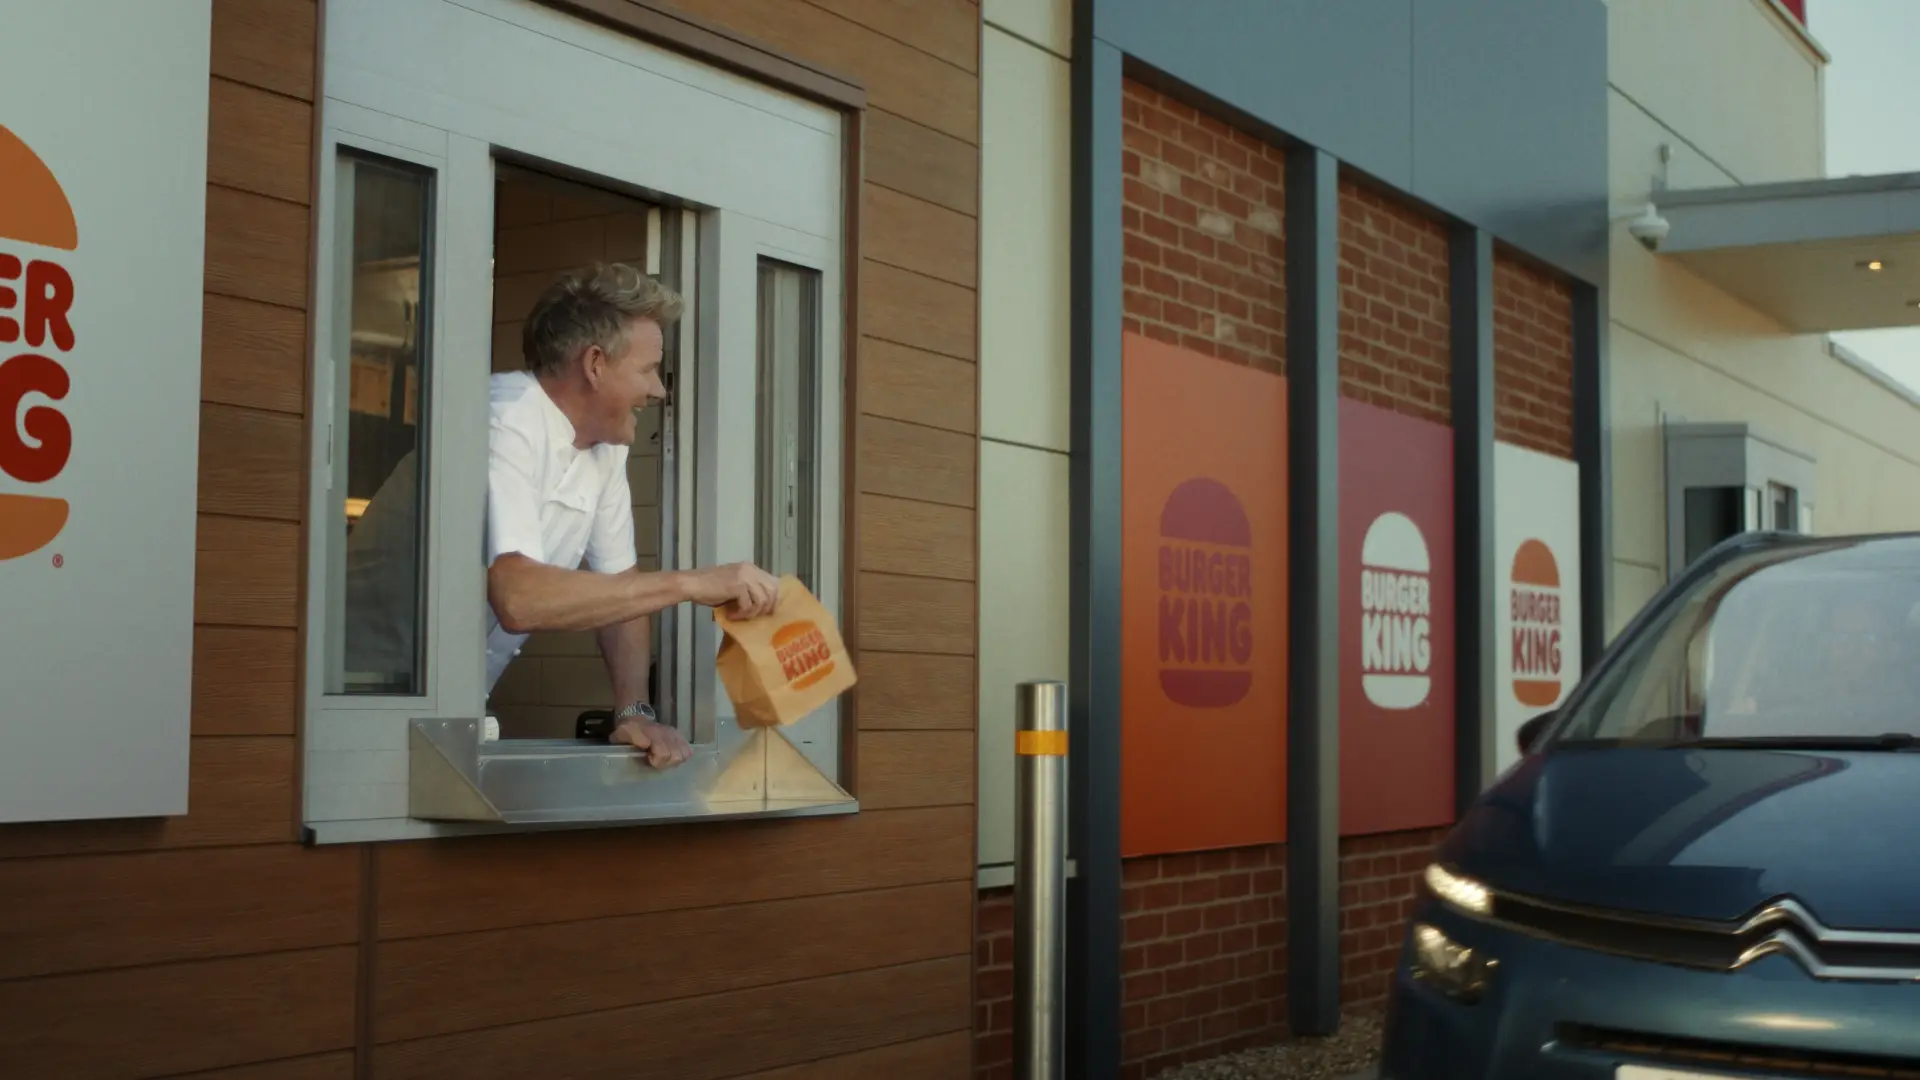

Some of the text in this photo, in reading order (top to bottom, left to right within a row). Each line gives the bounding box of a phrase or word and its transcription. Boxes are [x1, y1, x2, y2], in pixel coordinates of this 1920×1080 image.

[1159, 546, 1252, 598] BURGER
[1361, 569, 1430, 616] BURGER
[1159, 595, 1254, 664] KING
[1511, 588, 1560, 624] BURGER
[782, 643, 831, 681] KING
[1361, 612, 1430, 673] KING
[1511, 628, 1562, 675] KING
